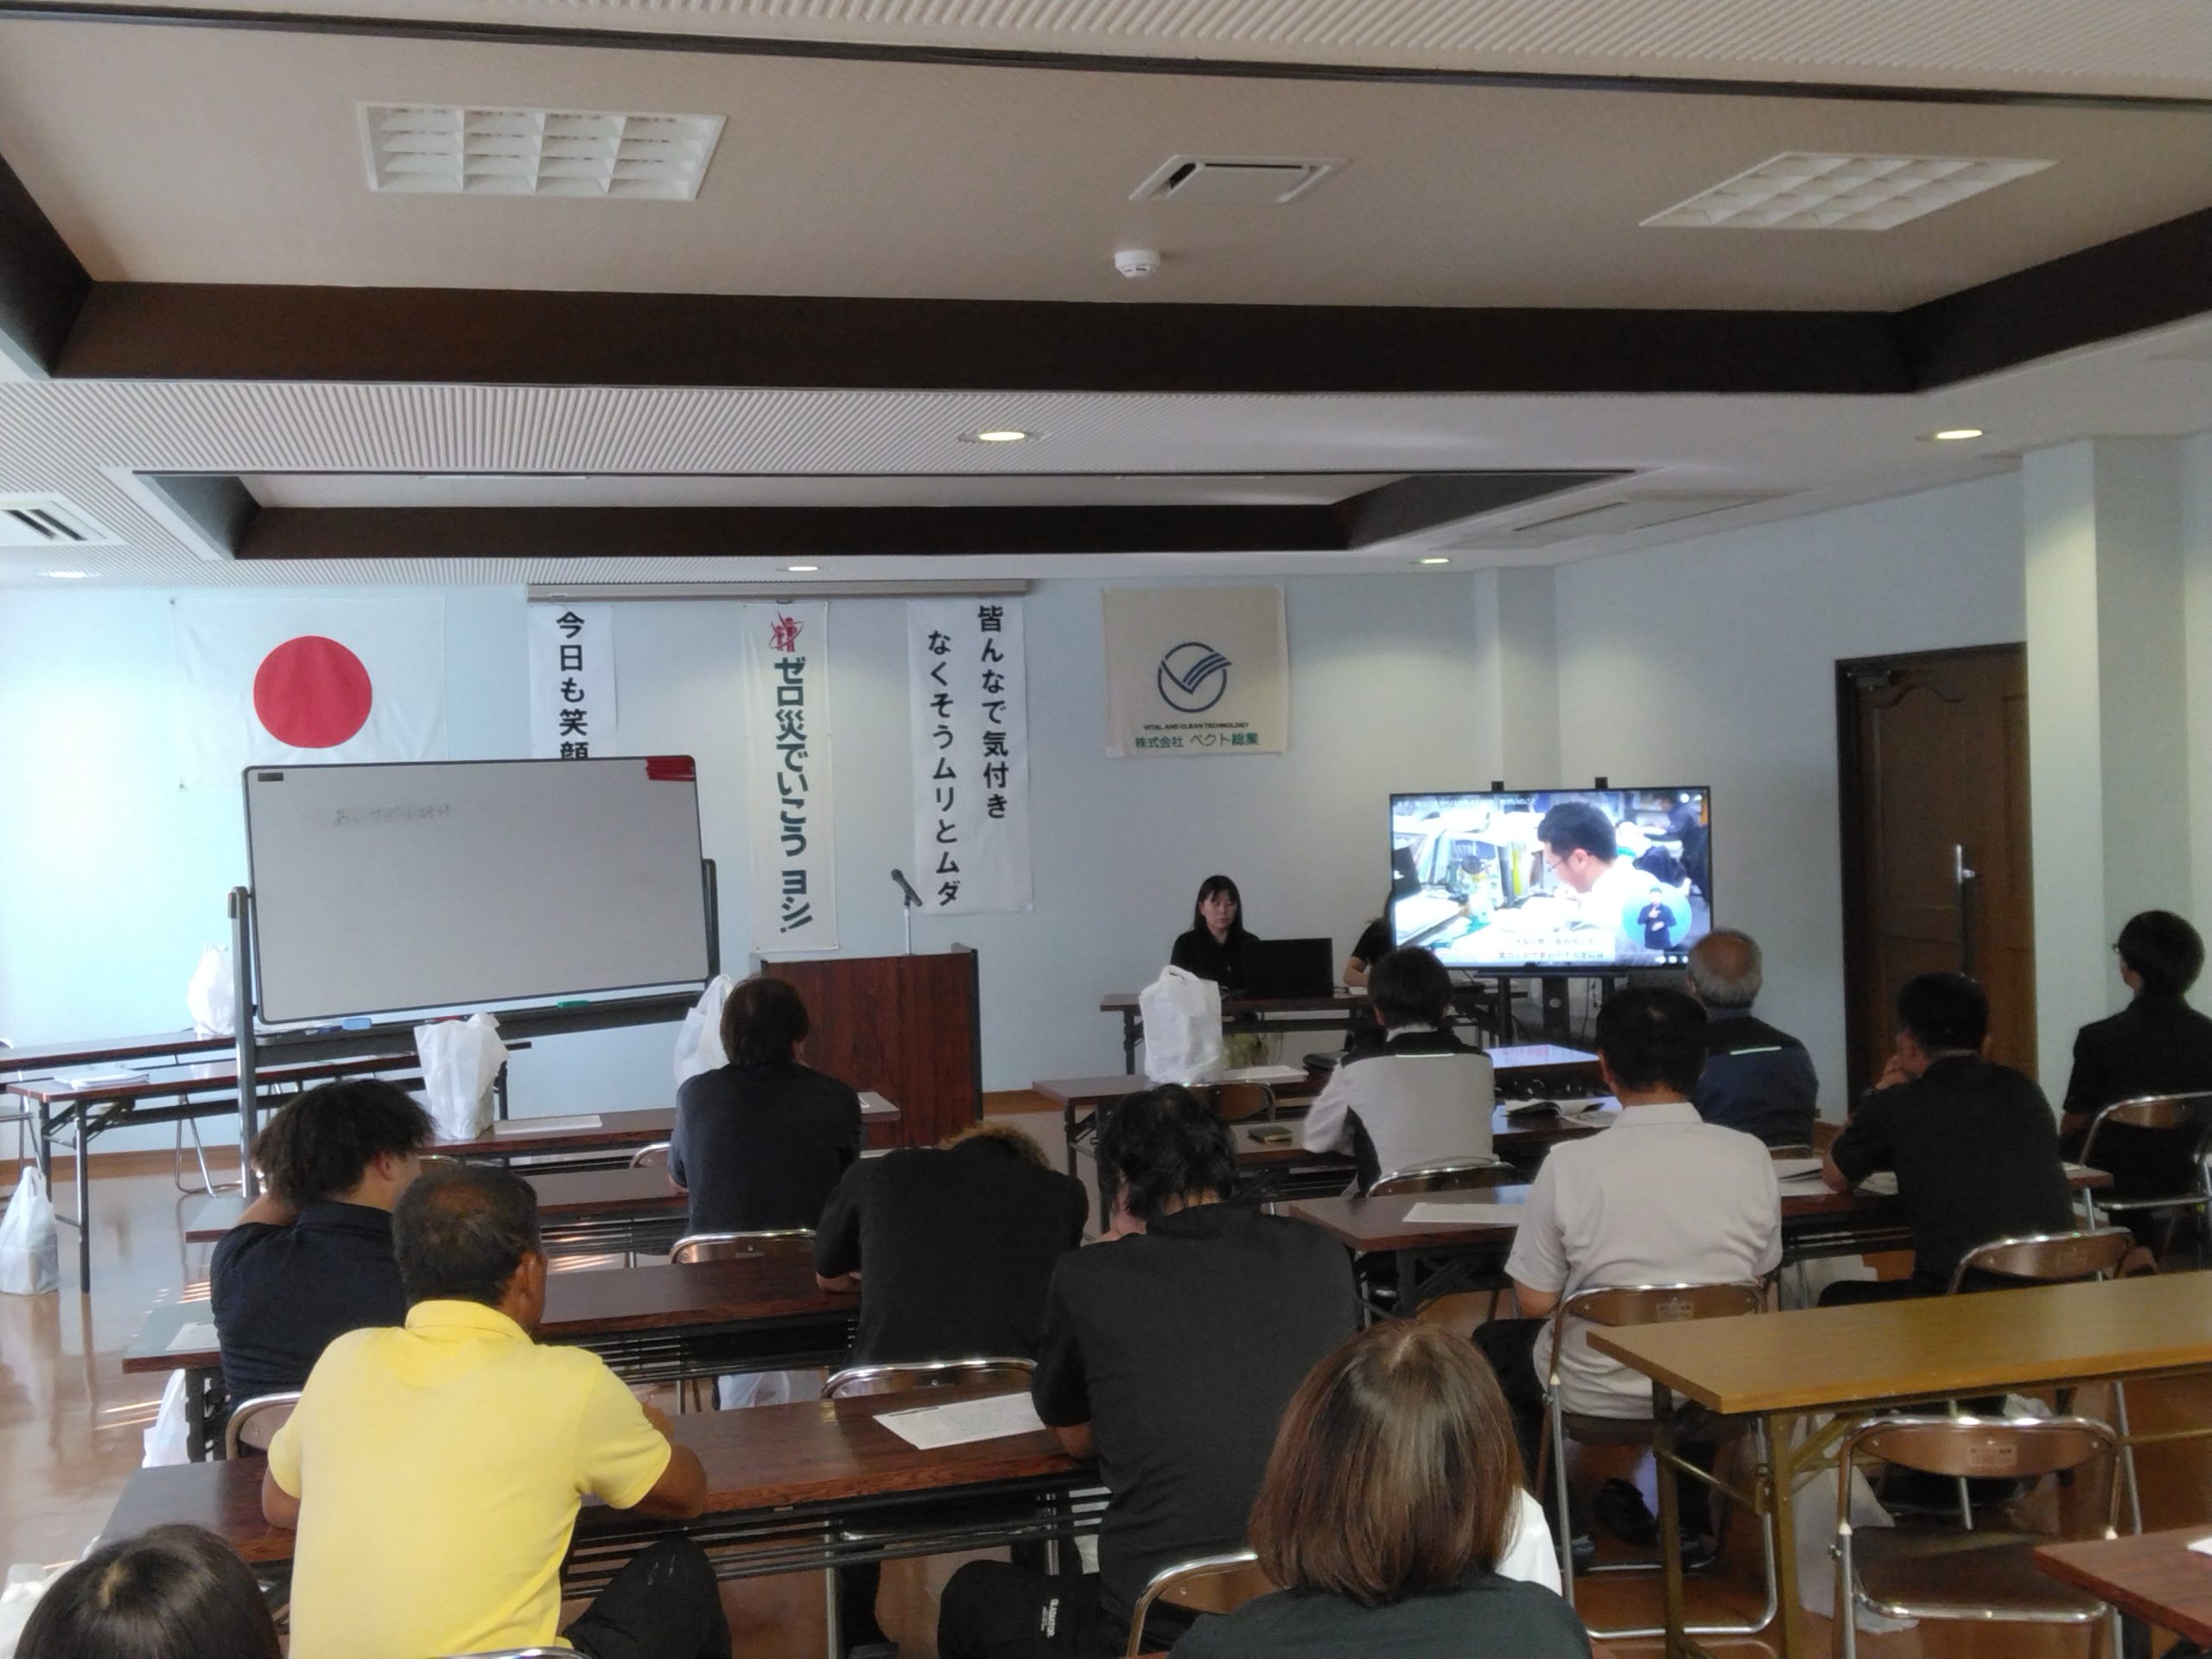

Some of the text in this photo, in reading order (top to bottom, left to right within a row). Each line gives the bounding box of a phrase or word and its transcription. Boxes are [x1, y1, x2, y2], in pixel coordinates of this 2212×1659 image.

[556, 611, 589, 760] 今日も笑顔
[774, 657, 809, 857] ゼロ災でいこう
[928, 630, 961, 906] なくそうムリとムダ
[977, 605, 1009, 819] 皆んなで気付き
[1135, 735, 1184, 748] 株式会社
